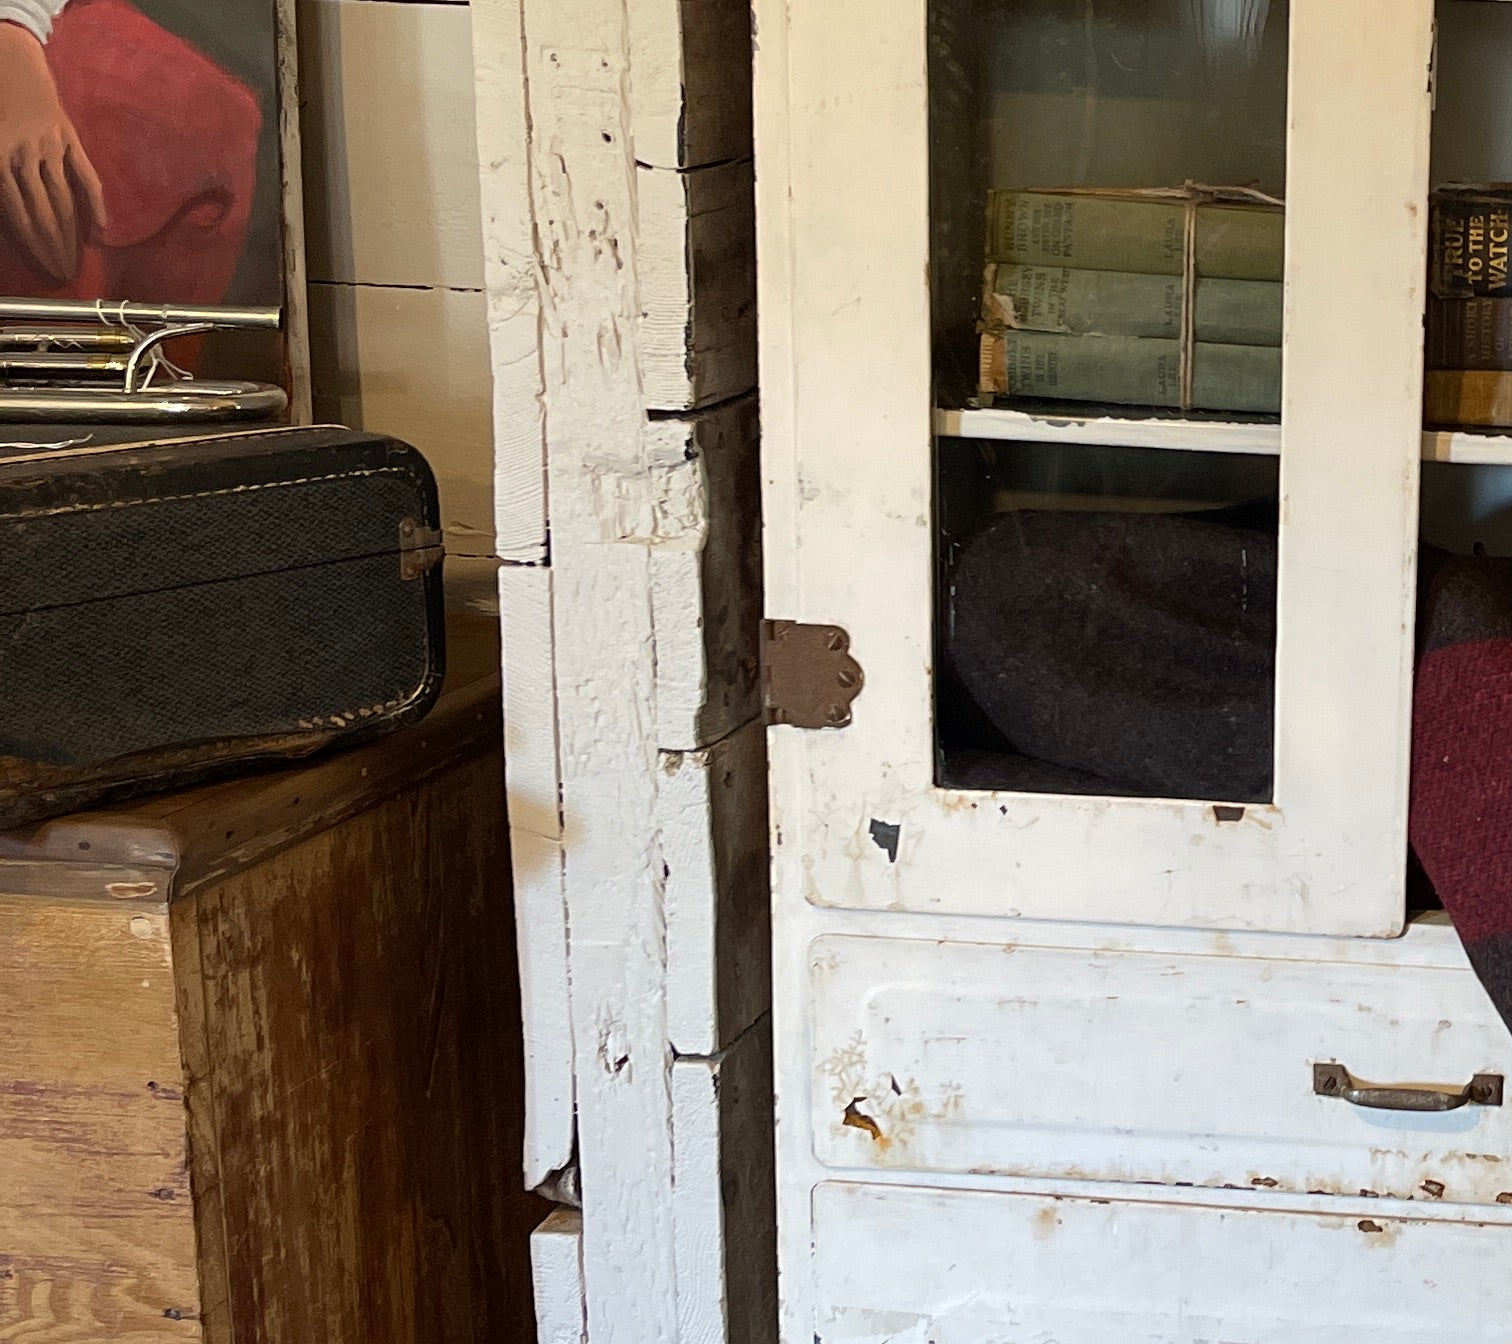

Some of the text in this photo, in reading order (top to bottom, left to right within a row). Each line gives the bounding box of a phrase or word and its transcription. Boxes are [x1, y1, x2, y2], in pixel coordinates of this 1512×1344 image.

[1016, 200, 1029, 252] BROWN
[1444, 218, 1464, 280] TRUE
[1467, 215, 1484, 284] TO THE
[1033, 272, 1046, 317] TWINS
[1156, 354, 1167, 395] LAURA
